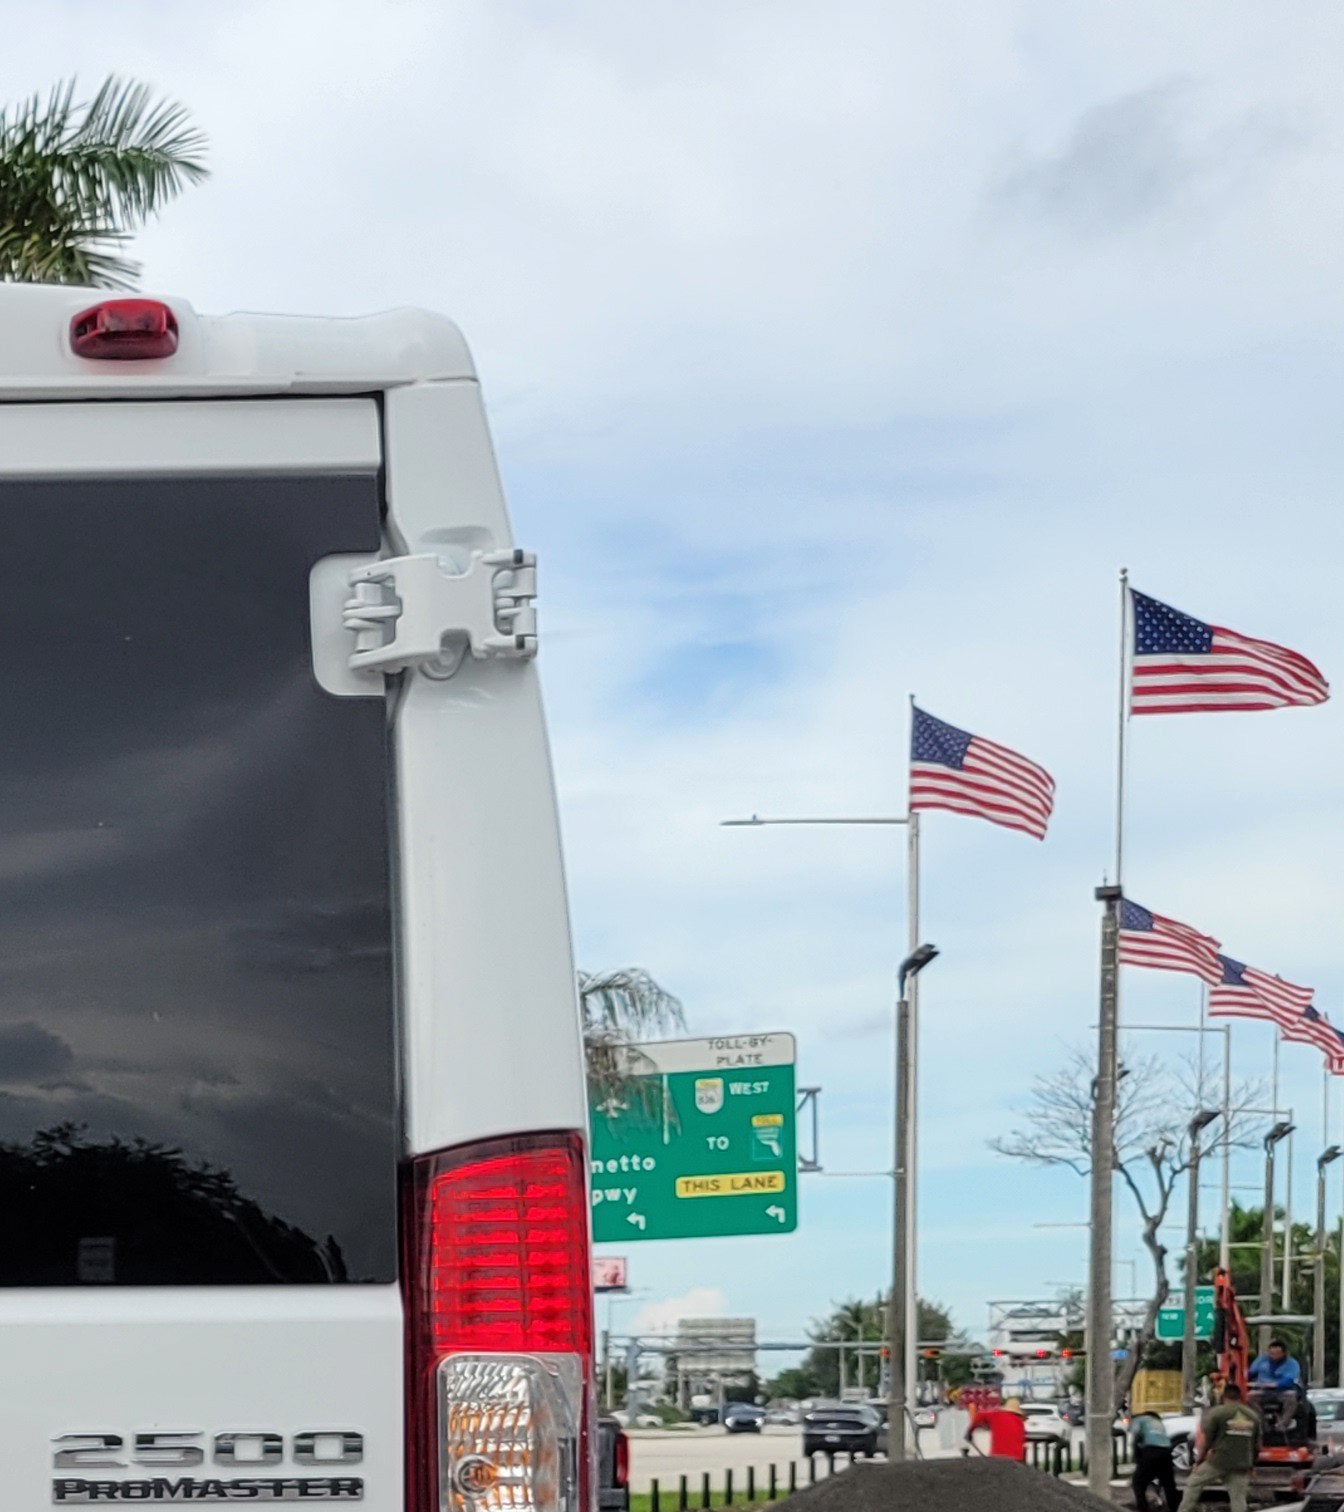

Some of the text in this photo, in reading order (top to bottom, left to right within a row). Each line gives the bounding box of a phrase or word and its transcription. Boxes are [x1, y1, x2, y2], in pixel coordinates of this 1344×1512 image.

[716, 1053, 763, 1066] PLATE
[728, 1081, 770, 1096] WEST
[706, 1135, 730, 1151] TO
[683, 1175, 778, 1193] THIS LANE
[50, 1429, 365, 1469] 2500
